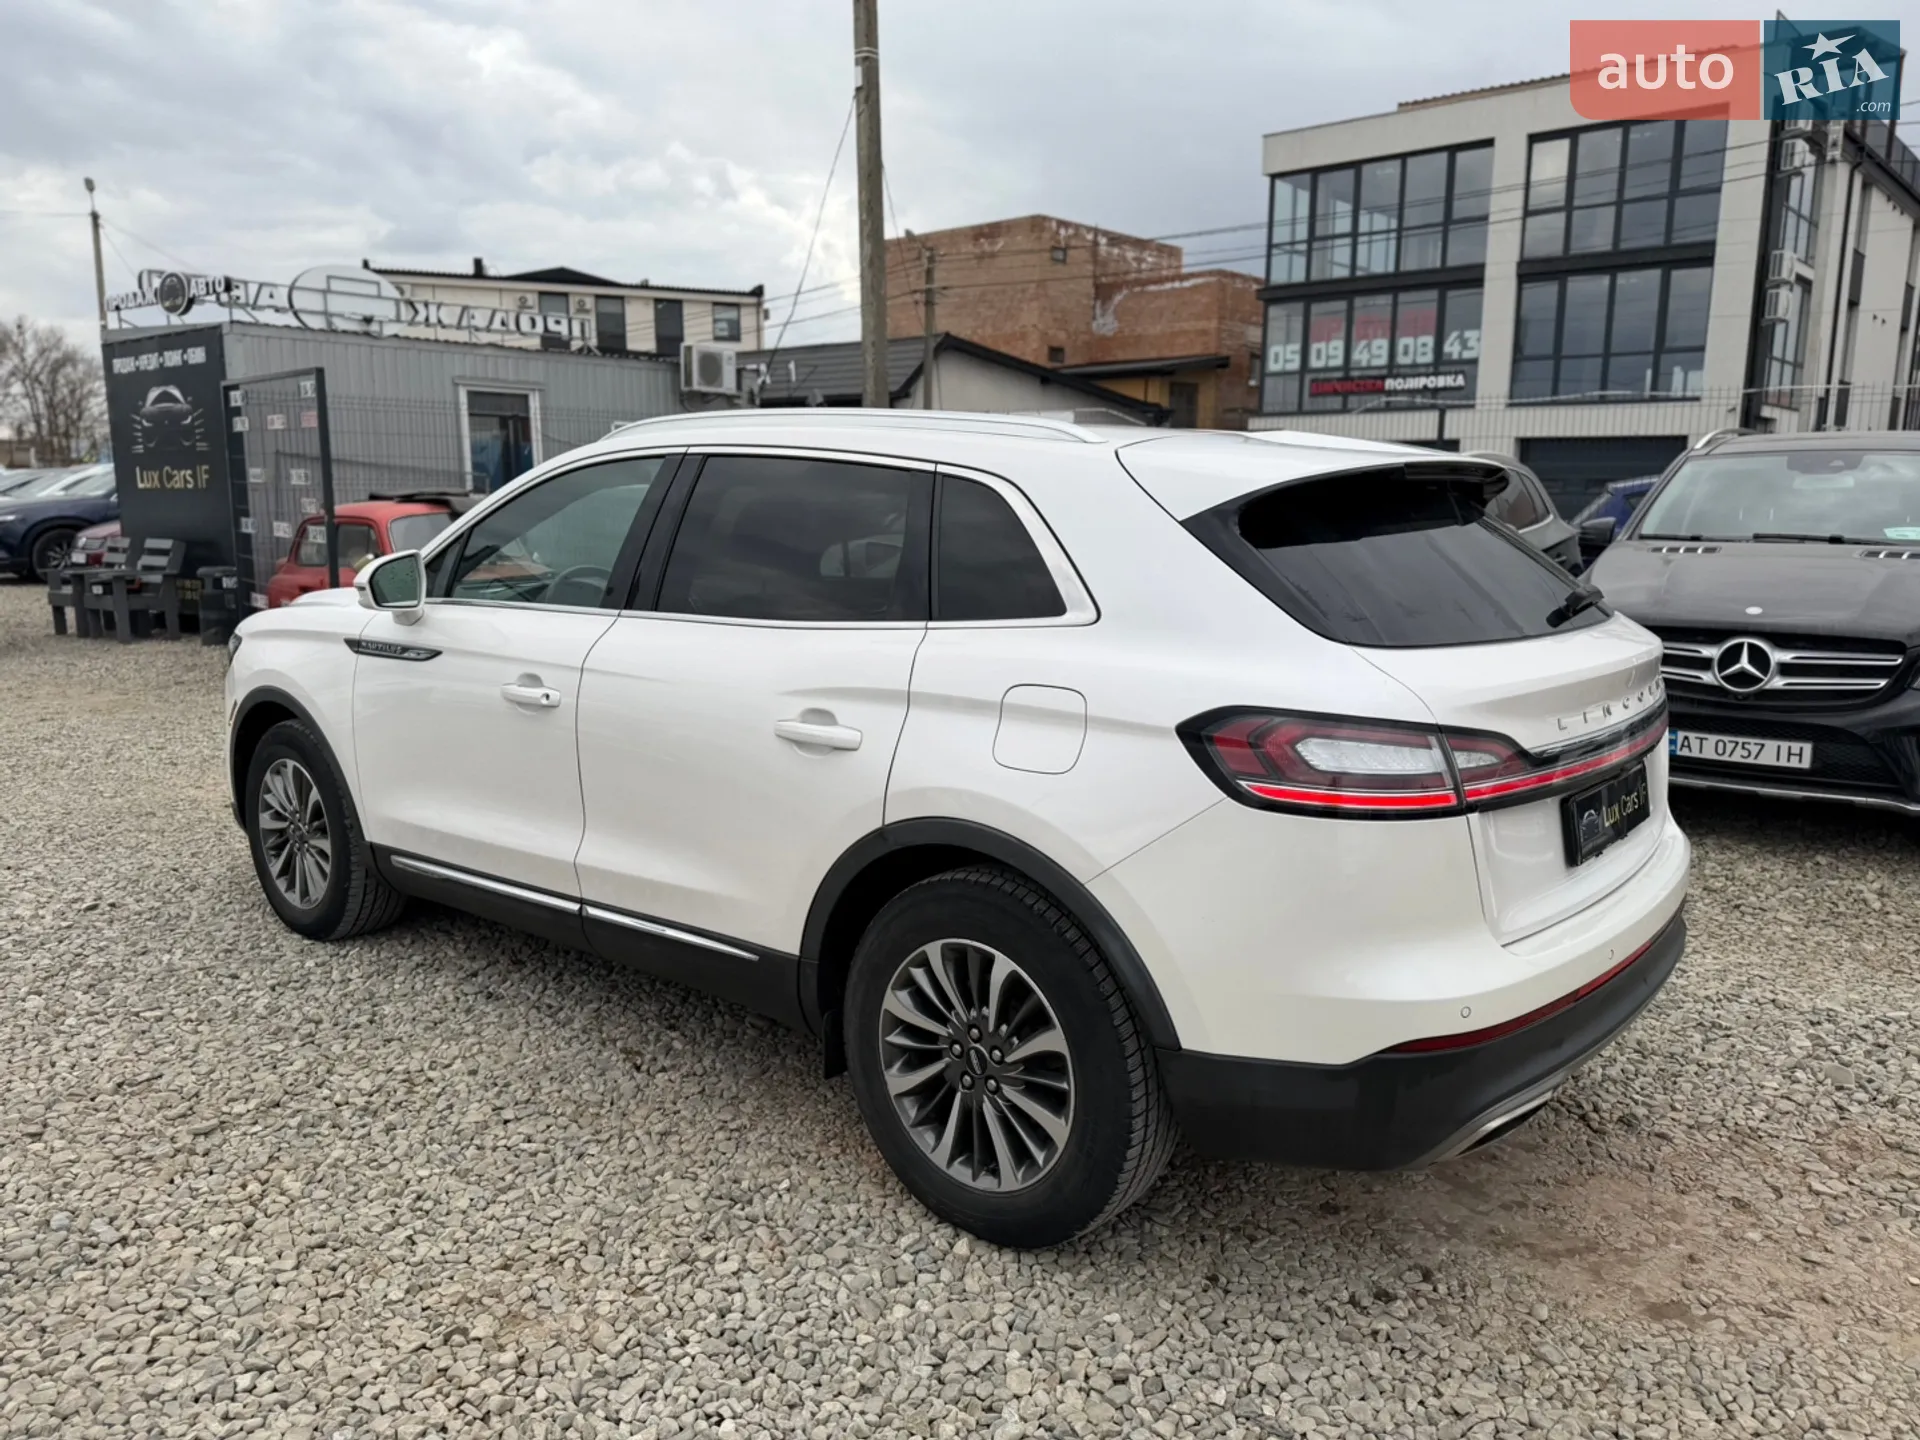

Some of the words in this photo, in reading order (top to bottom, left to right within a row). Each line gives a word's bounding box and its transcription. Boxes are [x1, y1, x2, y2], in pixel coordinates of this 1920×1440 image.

[189, 276, 225, 300] АВТО
[135, 465, 161, 489] Lux
[162, 465, 195, 489] Cars
[196, 464, 210, 489] IF
[1679, 735, 1709, 754] AT
[1714, 739, 1766, 761] 0757
[1775, 744, 1804, 764] IH
[1602, 802, 1620, 828] Lux
[1620, 791, 1639, 816] Cars
